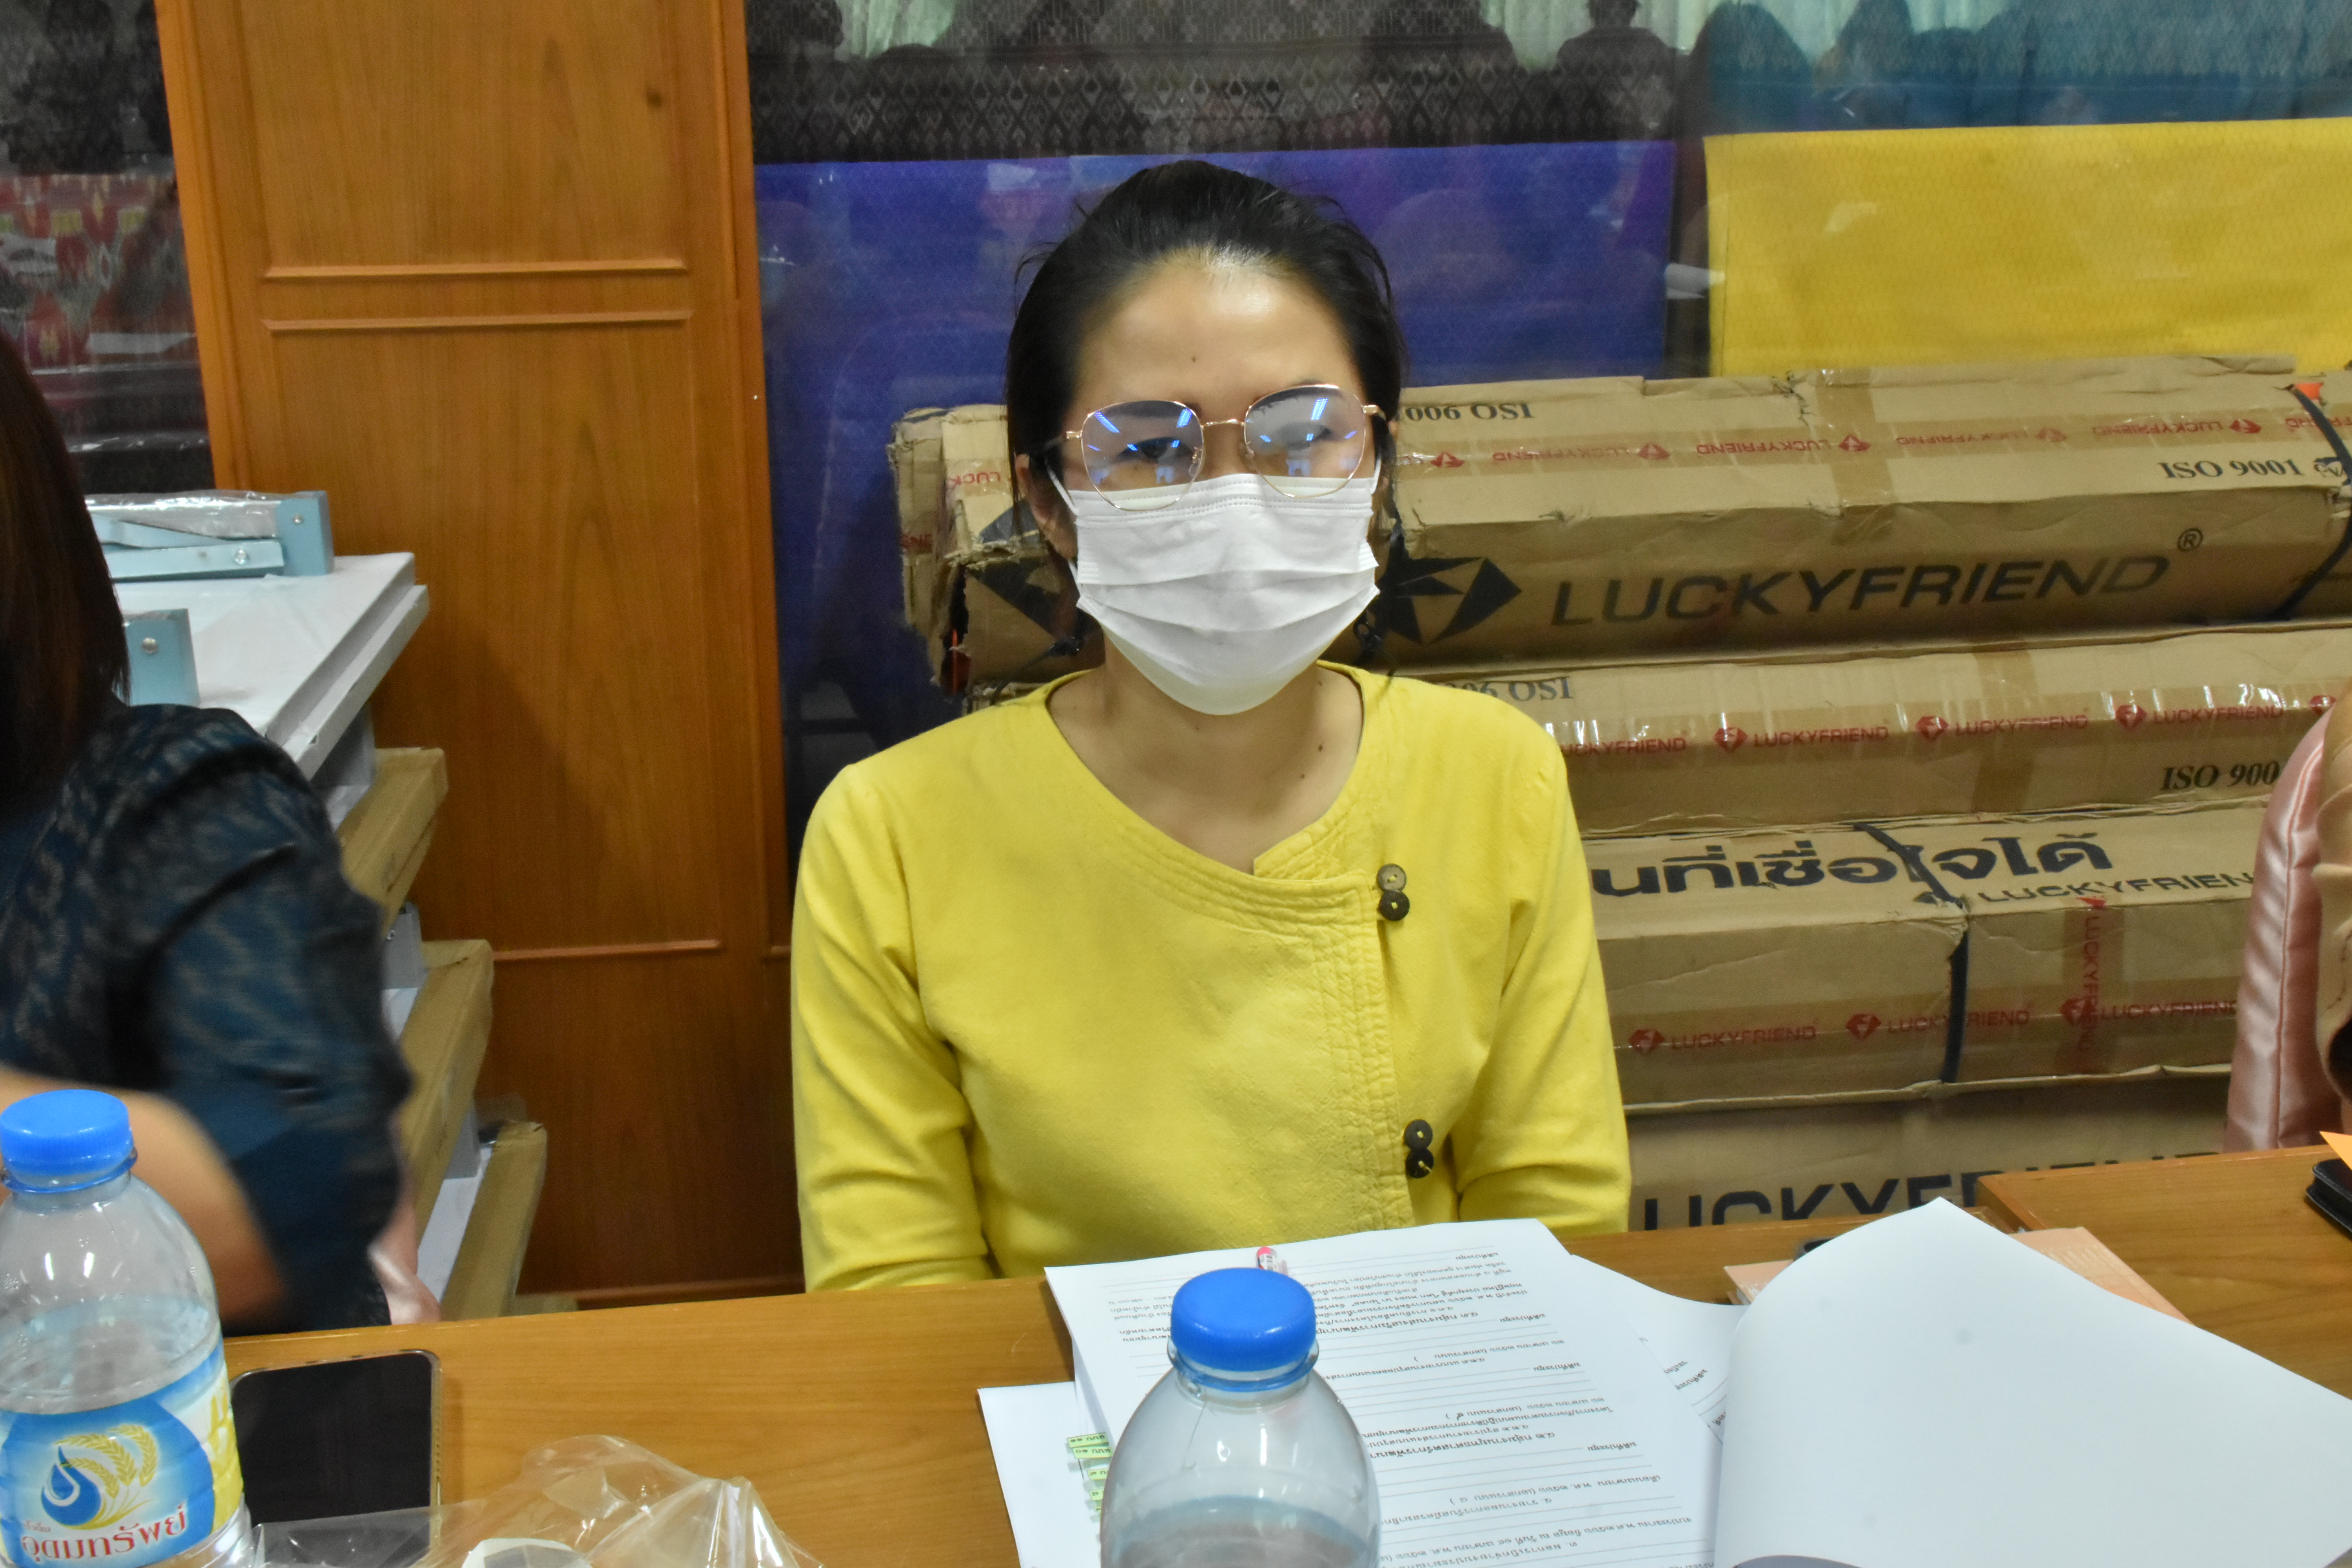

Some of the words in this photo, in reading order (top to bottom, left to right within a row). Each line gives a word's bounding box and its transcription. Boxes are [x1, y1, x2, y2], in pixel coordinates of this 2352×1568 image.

[1397, 405, 1461, 422] 900
[1696, 437, 1829, 455] LUCKYFRIEND
[2159, 460, 2223, 479] ISO
[2229, 459, 2306, 477] 9001
[1551, 555, 2171, 626] LUCKYFRIEND
[1560, 737, 1687, 757] UCKYFRIEND
[1753, 726, 1890, 748] LUCKYFRIEND
[1955, 714, 2089, 737] LUCKYFRIEND
[2152, 704, 2284, 725] LUCKYFRIEND
[2160, 764, 2220, 792] ISO
[2229, 759, 2281, 785] 900
[1978, 873, 2254, 902] LUCKYFRIEN
[1671, 1024, 1817, 1051] LUCKYFRIEND
[1887, 1008, 2030, 1035] LUCKYRIEND
[1499, 1313, 1546, 1322] มติที่ประชุม
[1533, 1362, 1581, 1371] มติที่ประชุม
[1587, 1442, 1637, 1451] มติที่ประชุม
[21, 1501, 188, 1563] อุดมทรัพย์
